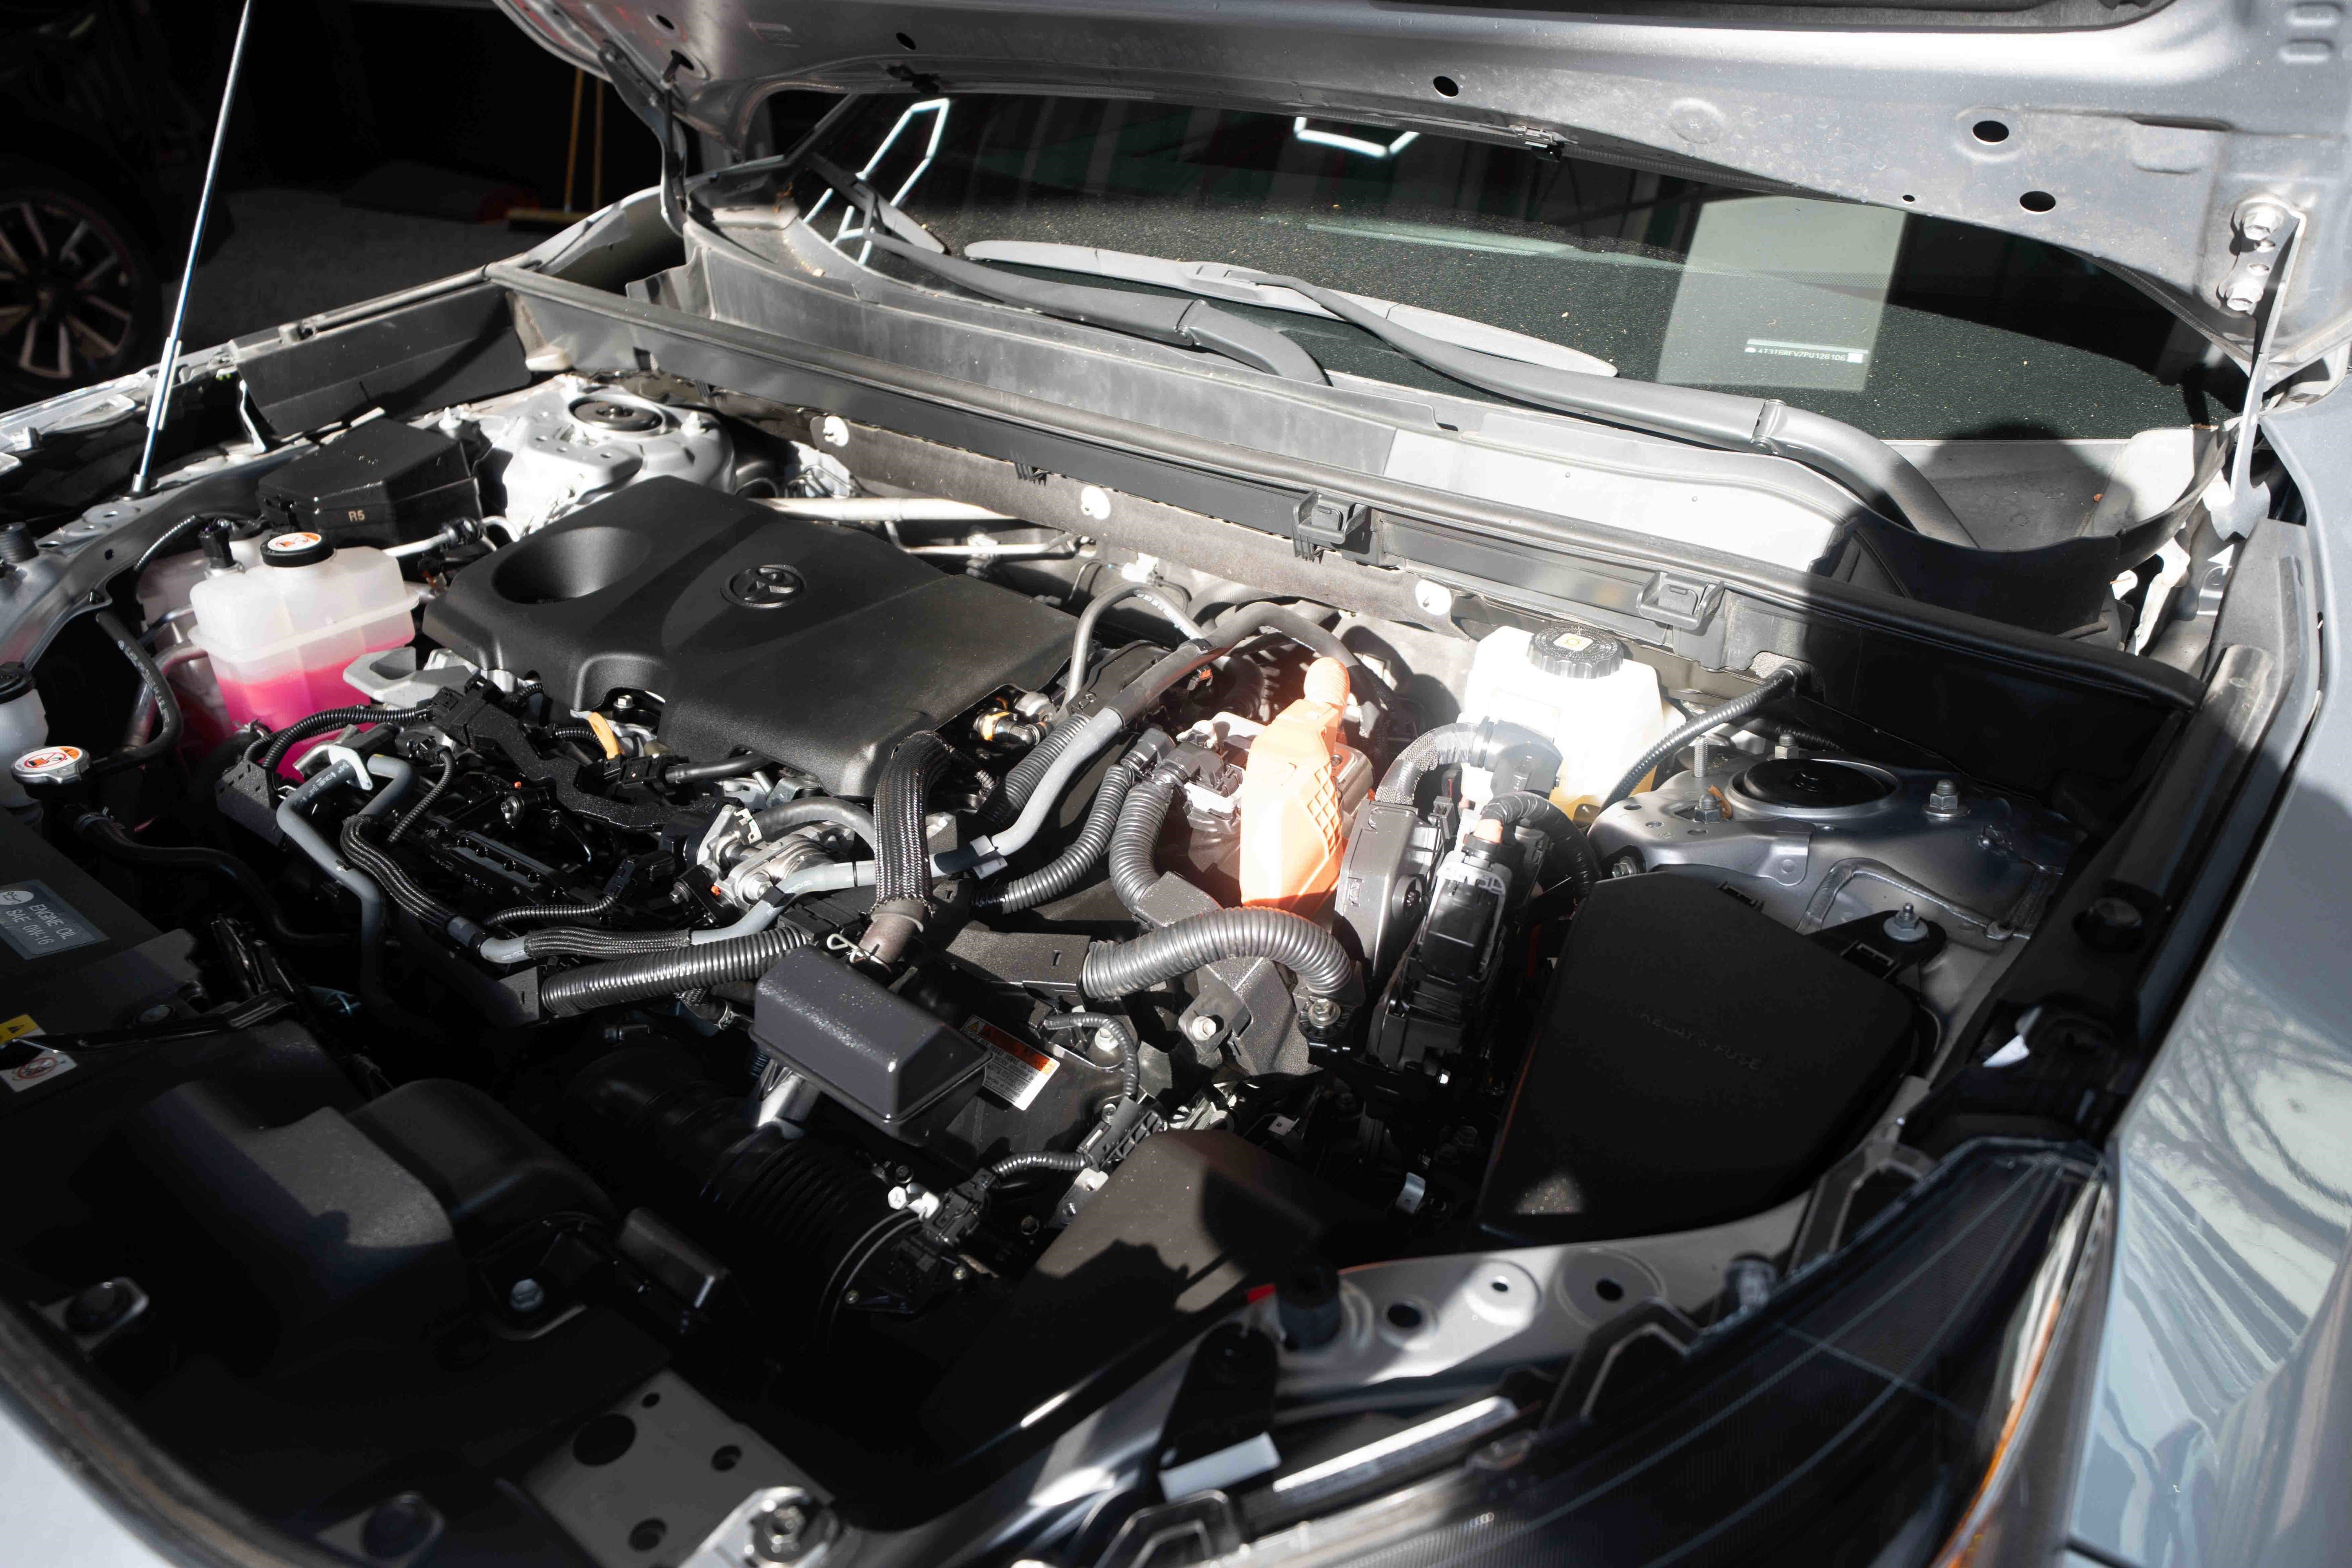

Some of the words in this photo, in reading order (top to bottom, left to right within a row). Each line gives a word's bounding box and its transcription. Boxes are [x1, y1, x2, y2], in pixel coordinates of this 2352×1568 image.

[348, 510, 365, 521] R5
[6, 909, 32, 923] SAE
[28, 904, 64, 927] ENGINE
[56, 928, 77, 940] OIL
[1713, 1043, 1761, 1072] FUSE
